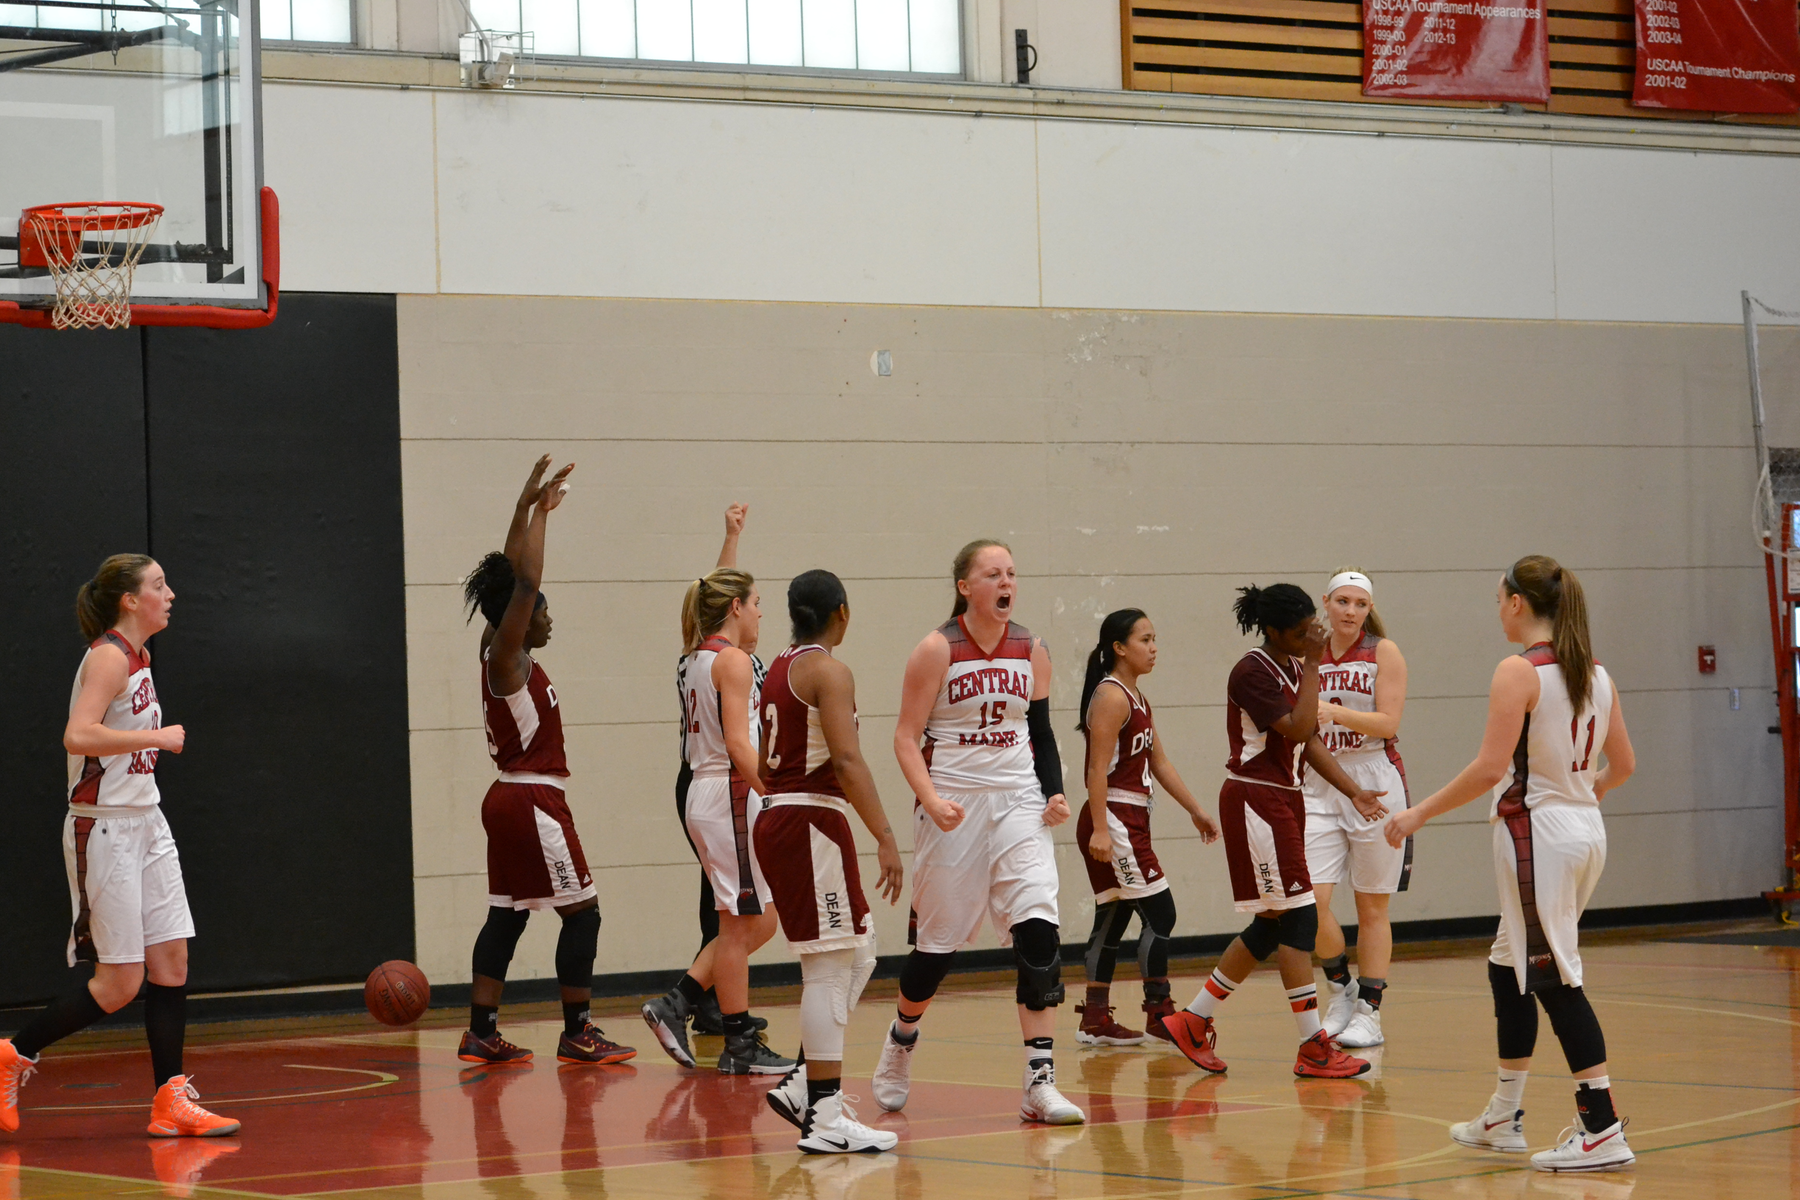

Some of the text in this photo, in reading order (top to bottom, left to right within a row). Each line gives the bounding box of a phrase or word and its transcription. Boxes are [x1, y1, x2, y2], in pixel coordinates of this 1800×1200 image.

[1373, 0, 1541, 19] USCAA Tournament Appearances
[1646, 0, 1678, 13] 2001-02
[1373, 15, 1404, 27] 1998-99
[1423, 17, 1455, 29] 2011-12
[1647, 15, 1680, 29] 2002-03
[1373, 30, 1405, 42] 1999-00
[1424, 32, 1456, 44] 2012-13
[1648, 31, 1682, 44] 2003-04
[1372, 45, 1406, 56] 2000-01
[1372, 59, 1407, 70] 2001-02
[1647, 58, 1796, 83] USCAA Tournament Champions
[1372, 74, 1407, 85] 2002-03
[1645, 74, 1687, 89] 2001-02
[948, 668, 1028, 705] CENTRAL
[1318, 670, 1373, 695] NTRAL
[978, 701, 1007, 730] 15
[1571, 715, 1596, 772] 11
[554, 860, 571, 890] DEAN
[1118, 857, 1136, 886] DEAN
[1258, 863, 1275, 894] DEAN
[825, 892, 842, 929] DEAN
